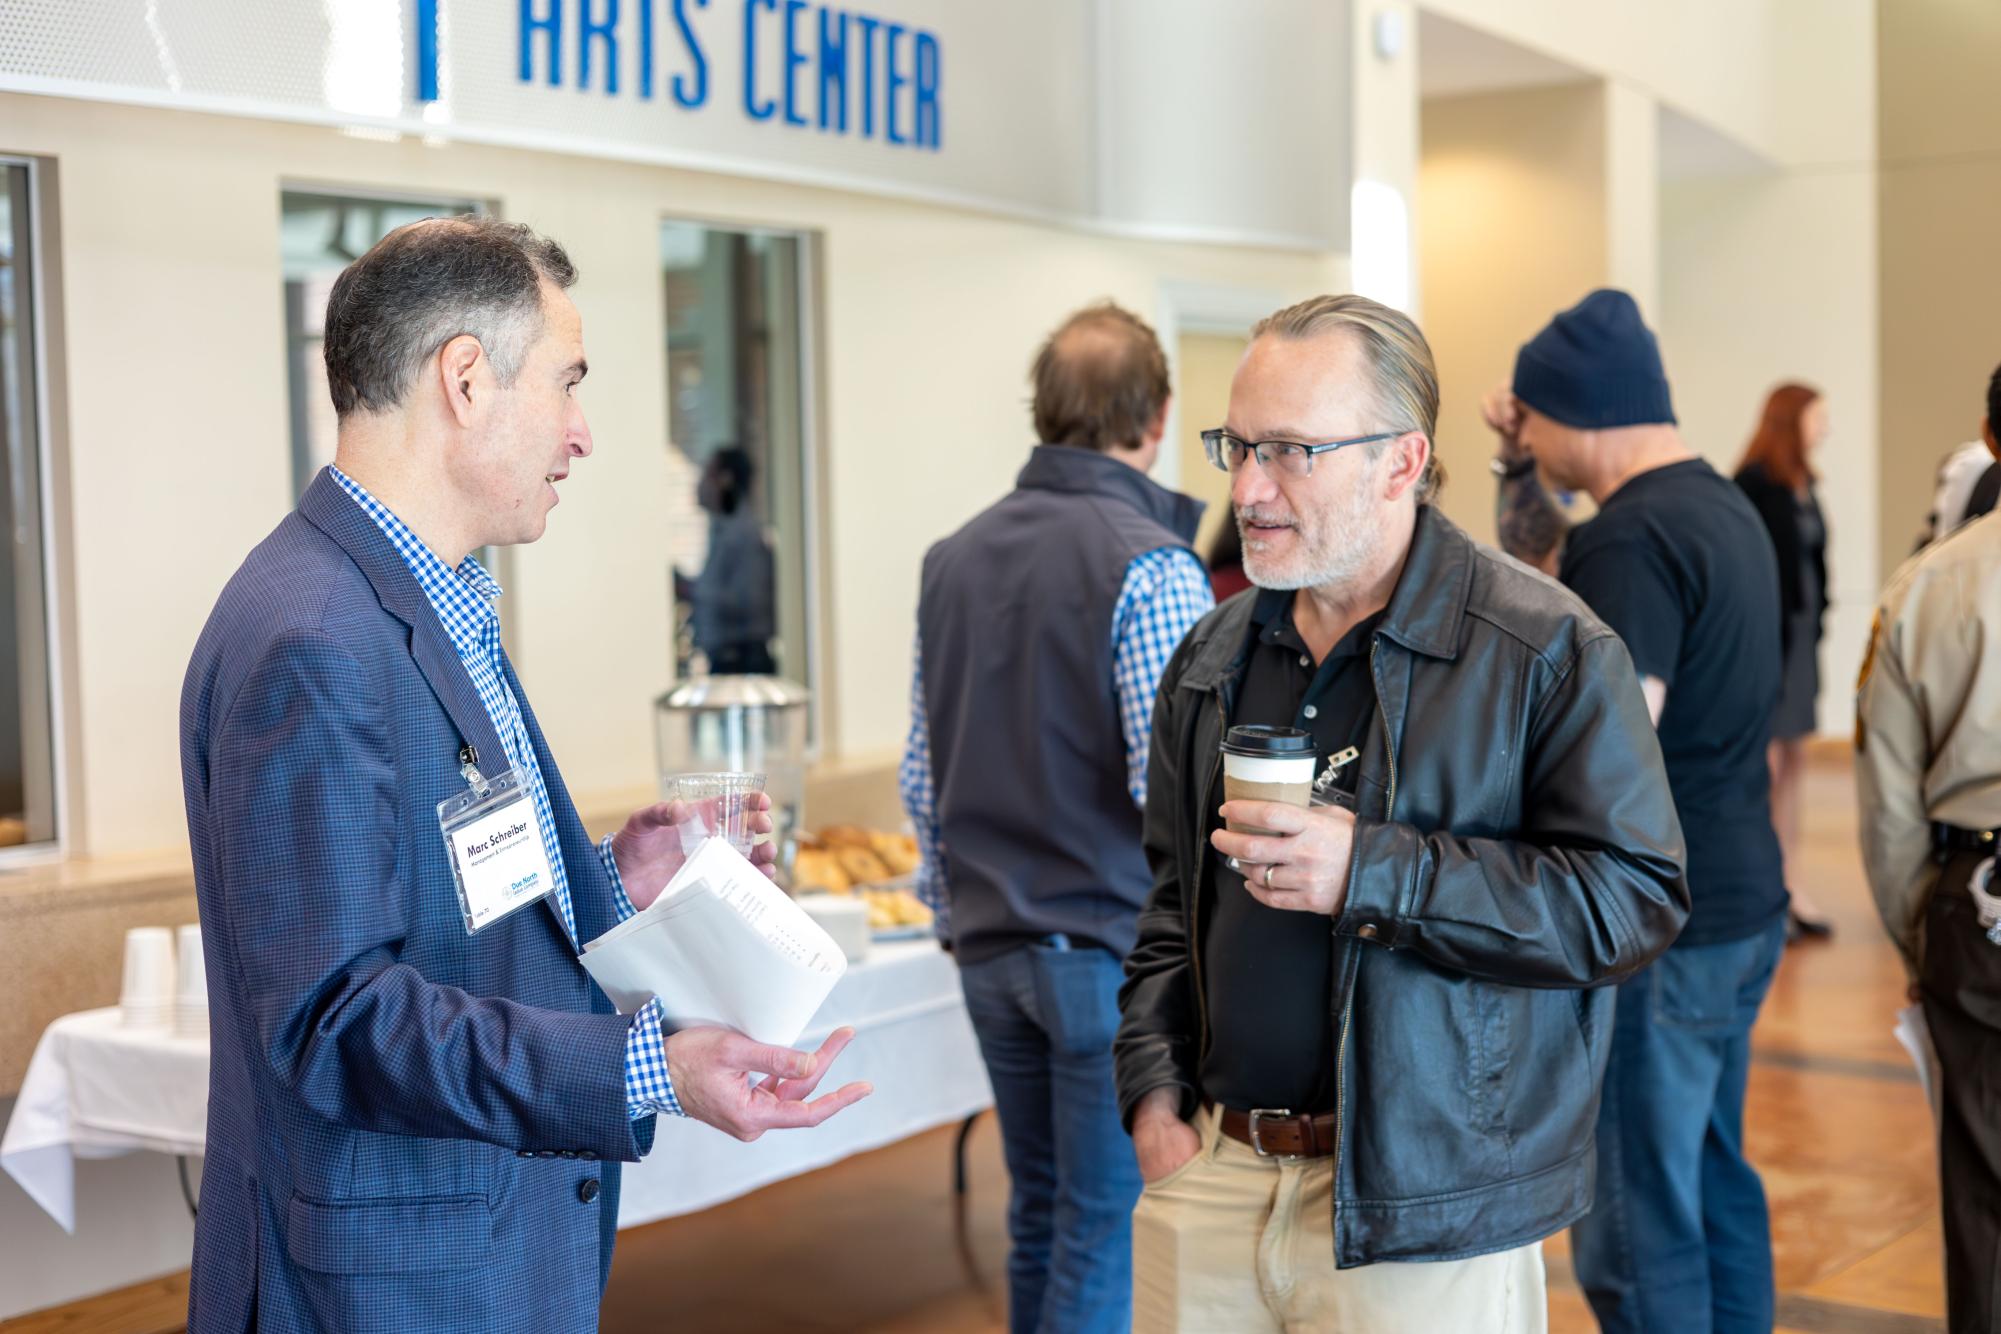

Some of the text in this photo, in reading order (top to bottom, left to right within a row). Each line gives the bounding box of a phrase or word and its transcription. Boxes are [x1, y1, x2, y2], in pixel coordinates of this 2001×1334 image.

[518, 0, 708, 109] ARTS
[742, 0, 942, 150] CENTER
[467, 822, 527, 858] Marc Schreiber
[522, 872, 538, 884] North
